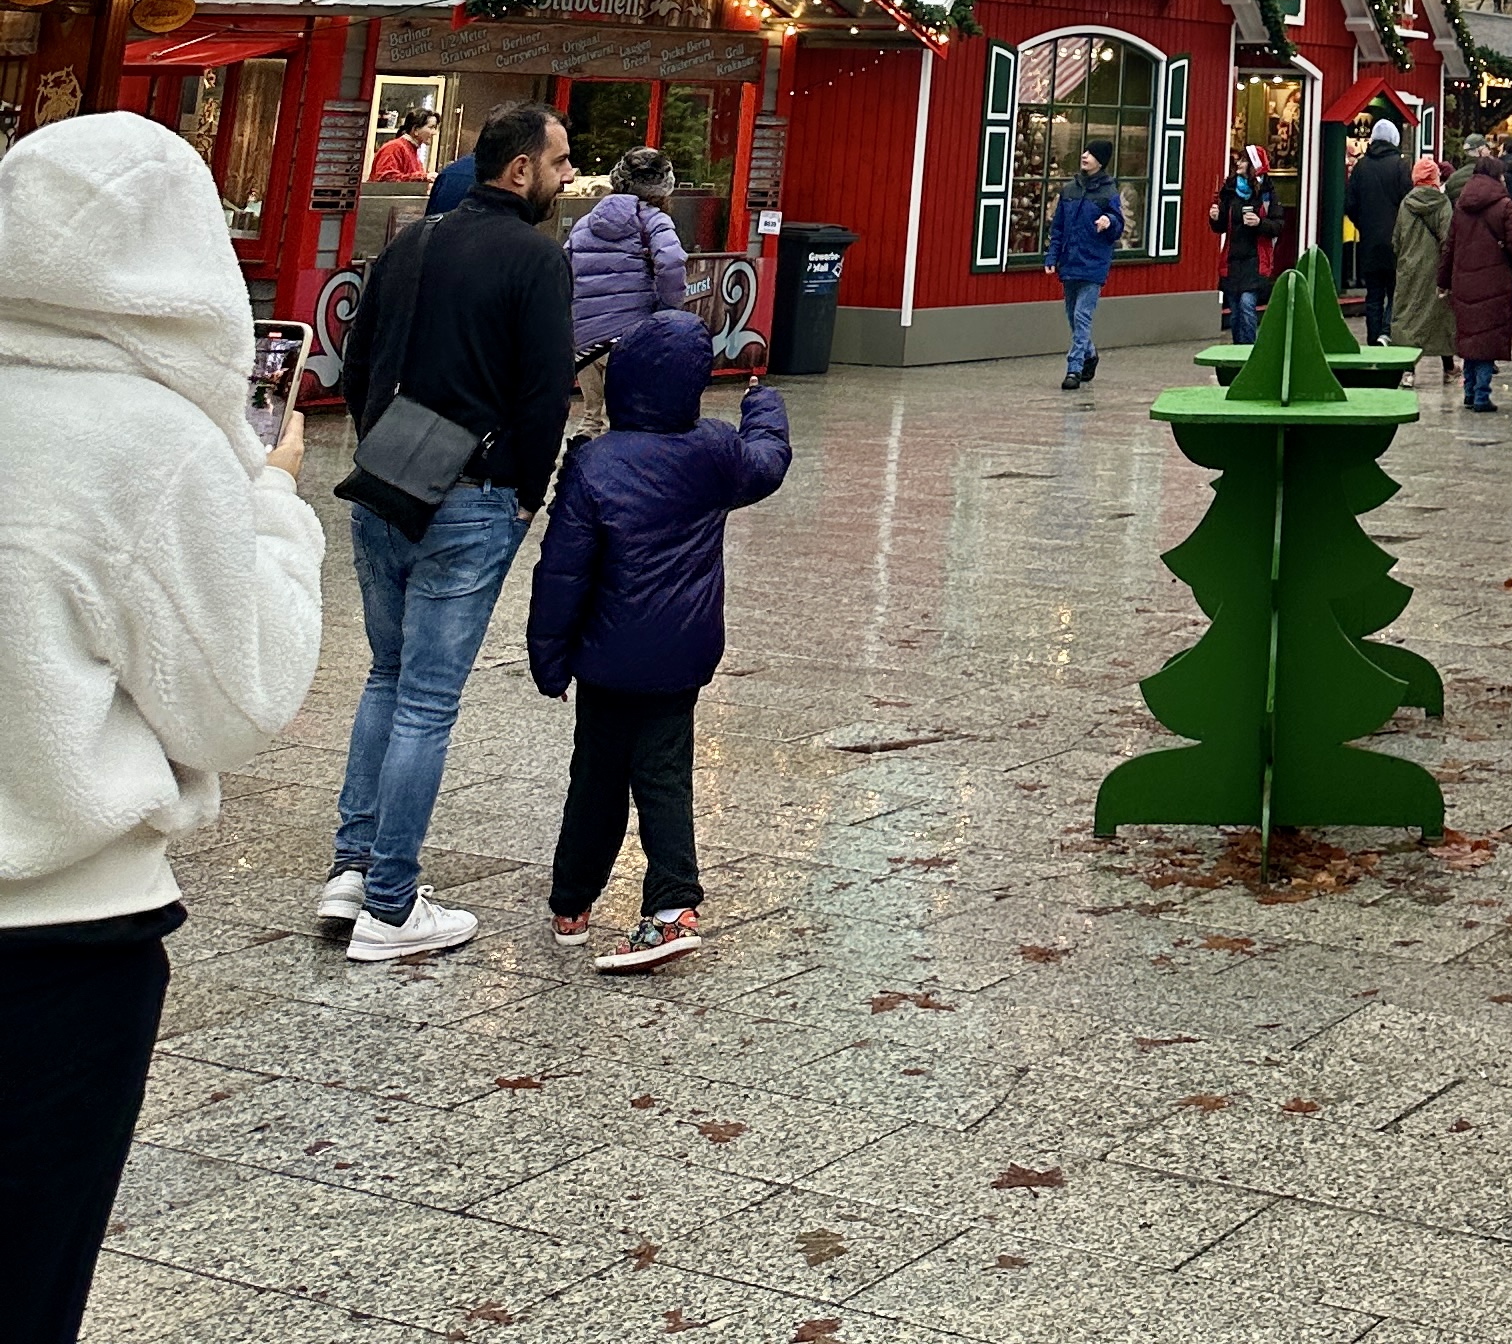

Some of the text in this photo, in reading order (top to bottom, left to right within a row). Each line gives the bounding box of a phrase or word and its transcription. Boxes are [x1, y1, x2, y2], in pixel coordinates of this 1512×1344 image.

[390, 27, 432, 47] Berliner
[502, 31, 541, 51] Berliner
[390, 41, 433, 62] Boulette
[440, 42, 491, 65] Bratwurst
[496, 42, 551, 68] Currywurst
[725, 43, 744, 59] Grill
